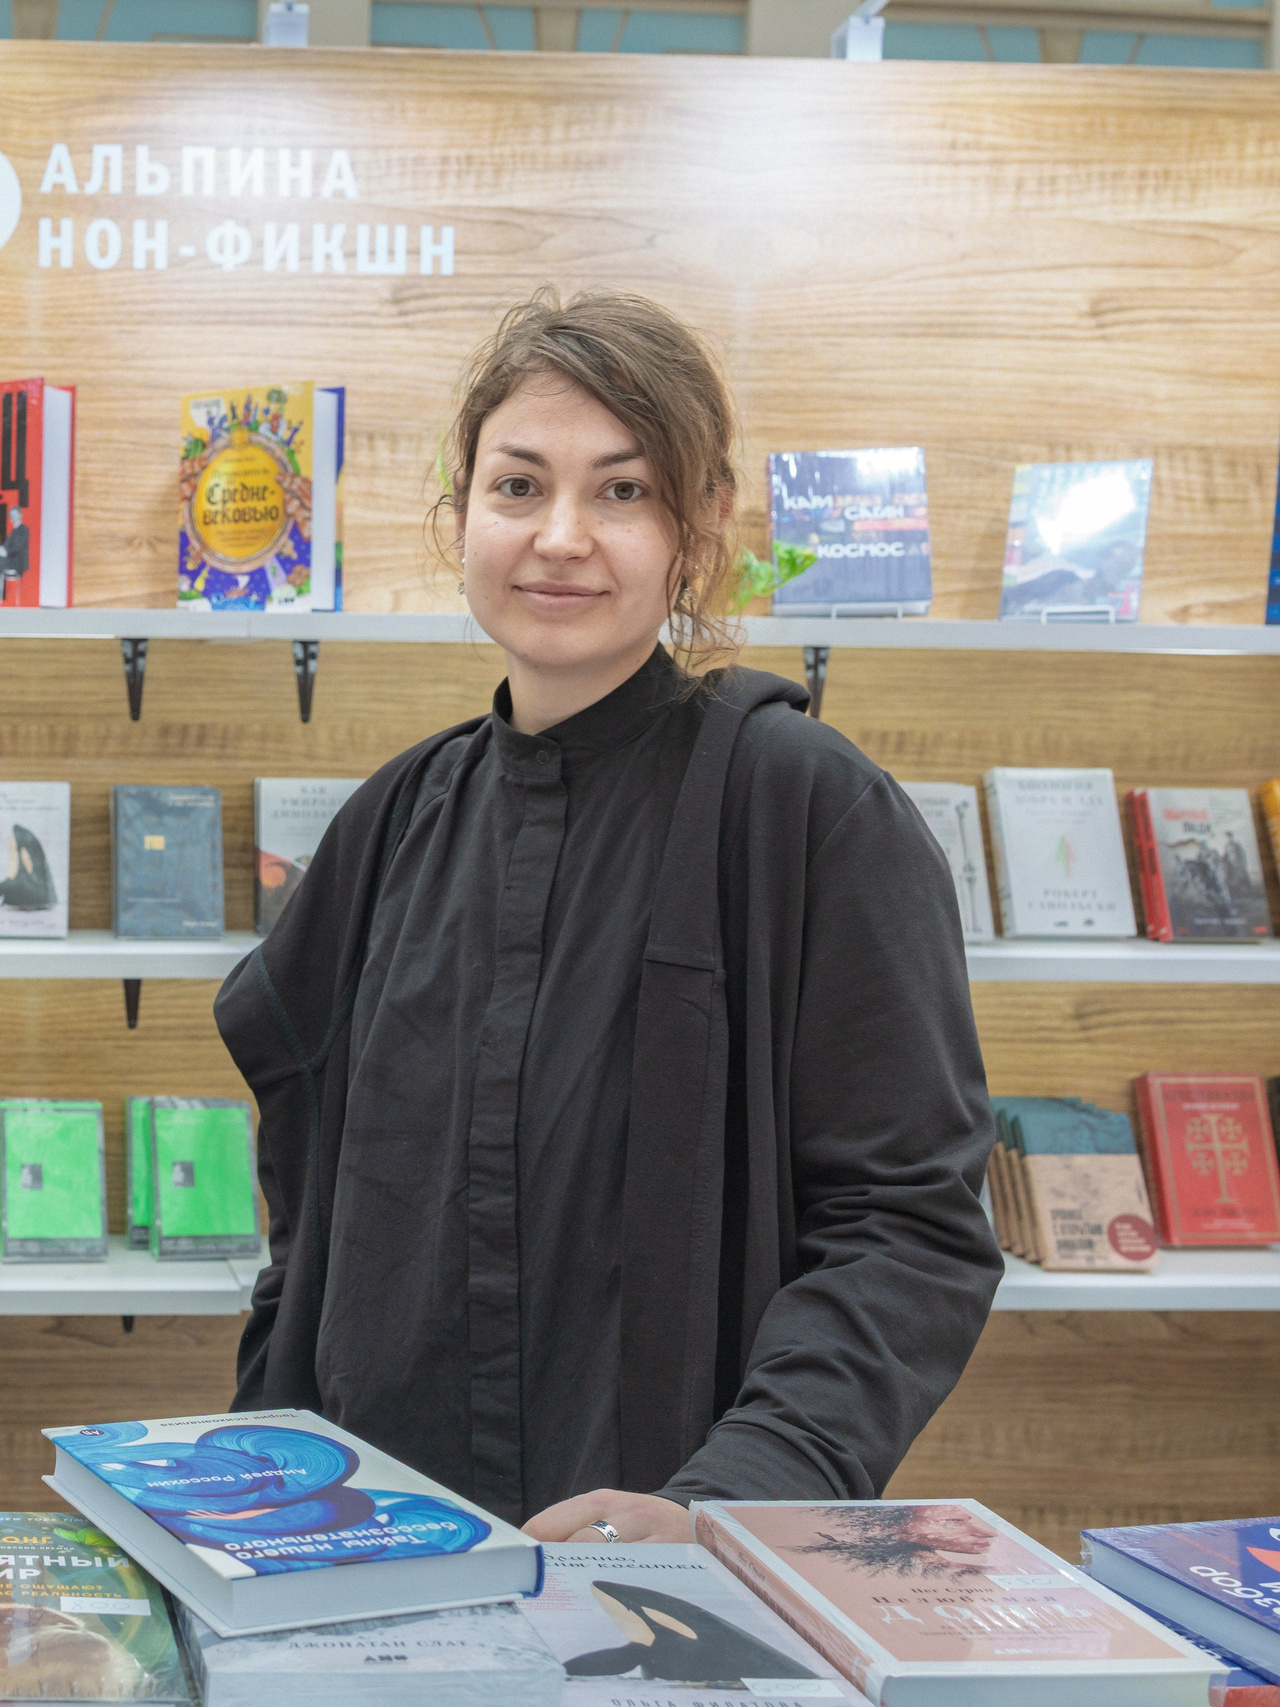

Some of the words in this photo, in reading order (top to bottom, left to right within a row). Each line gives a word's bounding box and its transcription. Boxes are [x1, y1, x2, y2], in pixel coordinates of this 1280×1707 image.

[39, 143, 357, 199] АЛЬПИНА
[38, 217, 455, 276] НОН-ФИКШН
[147, 1474, 236, 1488] Россохин
[241, 1468, 307, 1480] Андрей
[224, 1521, 458, 1551] бессознательного
[342, 1533, 427, 1548] Тайны
[235, 1542, 333, 1560] нашего
[544, 1550, 637, 1563] блачно,
[597, 1562, 709, 1571] косатки
[20, 1583, 104, 1591] ОЩУЩАЮТ
[288, 1640, 406, 1649] ДЖОНАТАН
